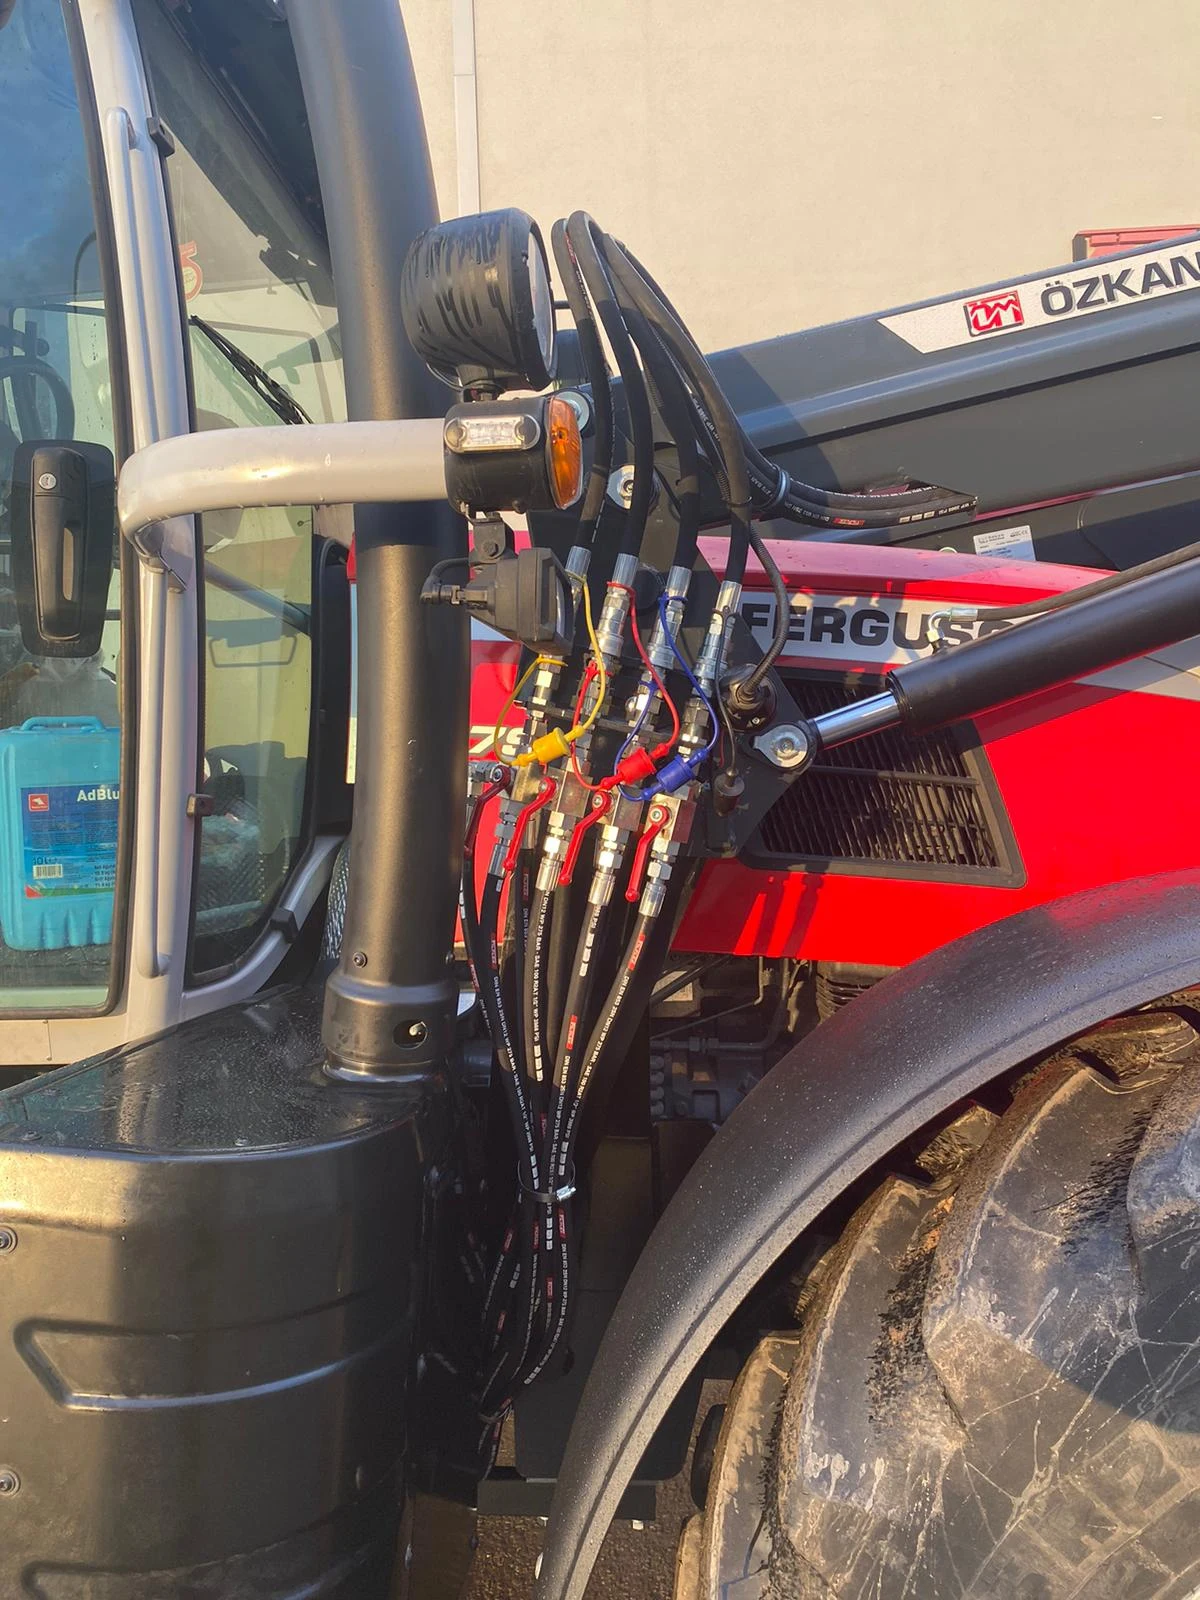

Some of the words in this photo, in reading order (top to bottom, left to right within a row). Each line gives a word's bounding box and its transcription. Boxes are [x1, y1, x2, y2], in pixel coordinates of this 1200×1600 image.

[1040, 251, 1200, 317] ÖZKAN
[742, 603, 1017, 651] FERGUS
[77, 789, 120, 802] AdBlu
[541, 897, 550, 913] DN12
[539, 913, 546, 925] WP
[621, 975, 630, 987] DIN
[495, 988, 502, 997] EN
[618, 986, 626, 996] EN
[533, 1009, 539, 1018] WP
[599, 1032, 608, 1042] WP
[590, 1050, 600, 1063] BAR
[510, 1057, 518, 1071] BAR
[563, 1066, 569, 1074] EN
[584, 1065, 594, 1077] SAE
[513, 1073, 521, 1086] SAE
